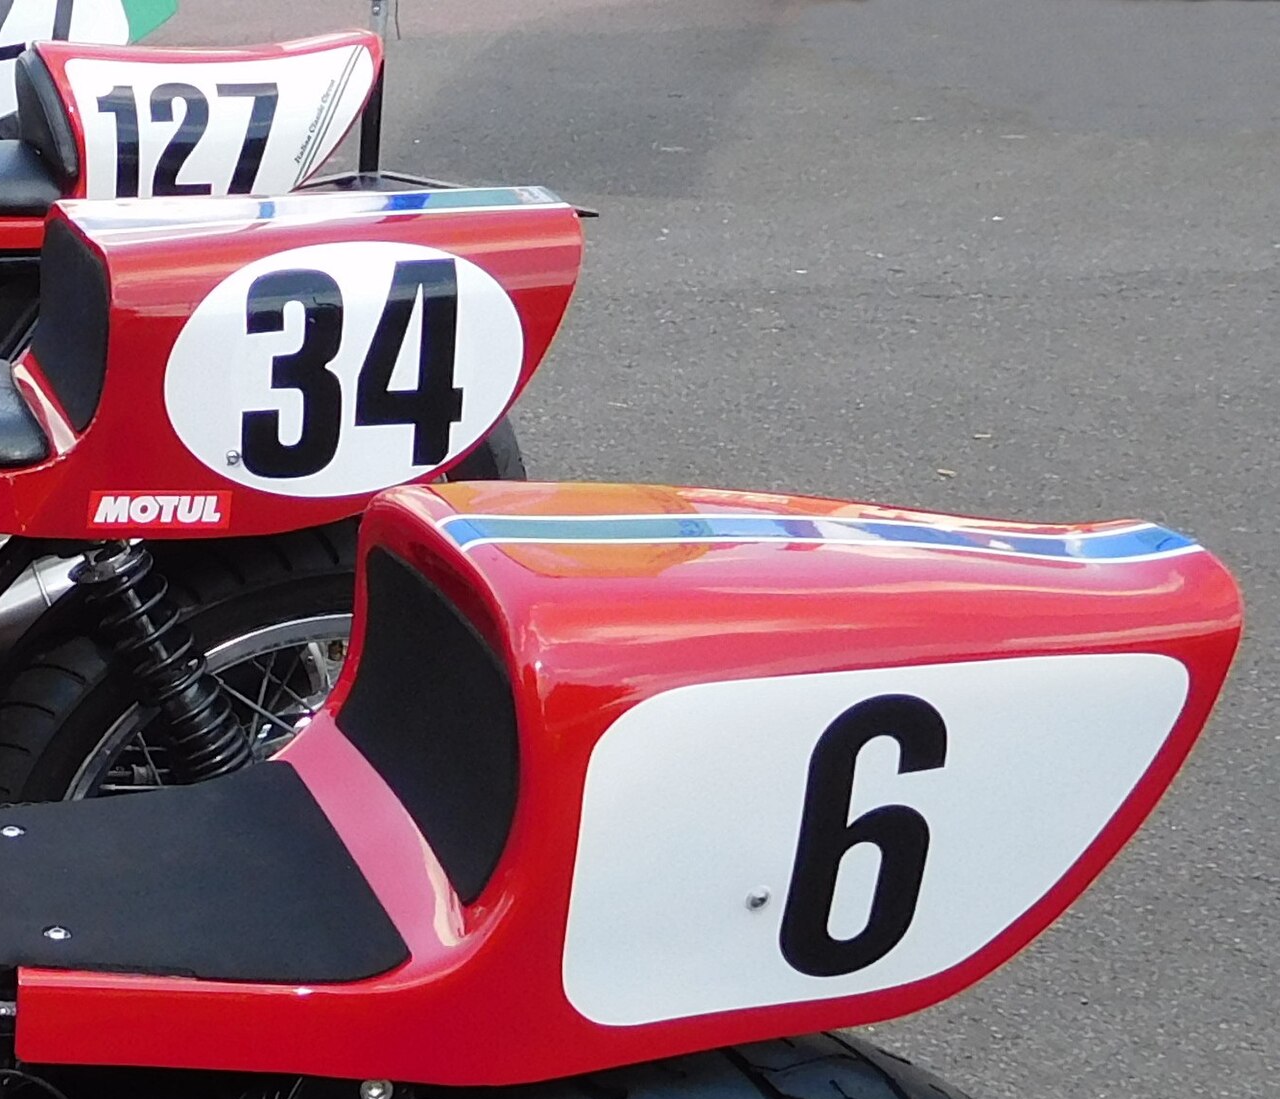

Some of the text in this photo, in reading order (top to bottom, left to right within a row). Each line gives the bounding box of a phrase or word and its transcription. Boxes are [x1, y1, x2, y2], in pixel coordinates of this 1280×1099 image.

[96, 82, 279, 198] 127
[241, 258, 464, 478] 34
[93, 496, 222, 524] MOTUL
[779, 694, 948, 977] 6
